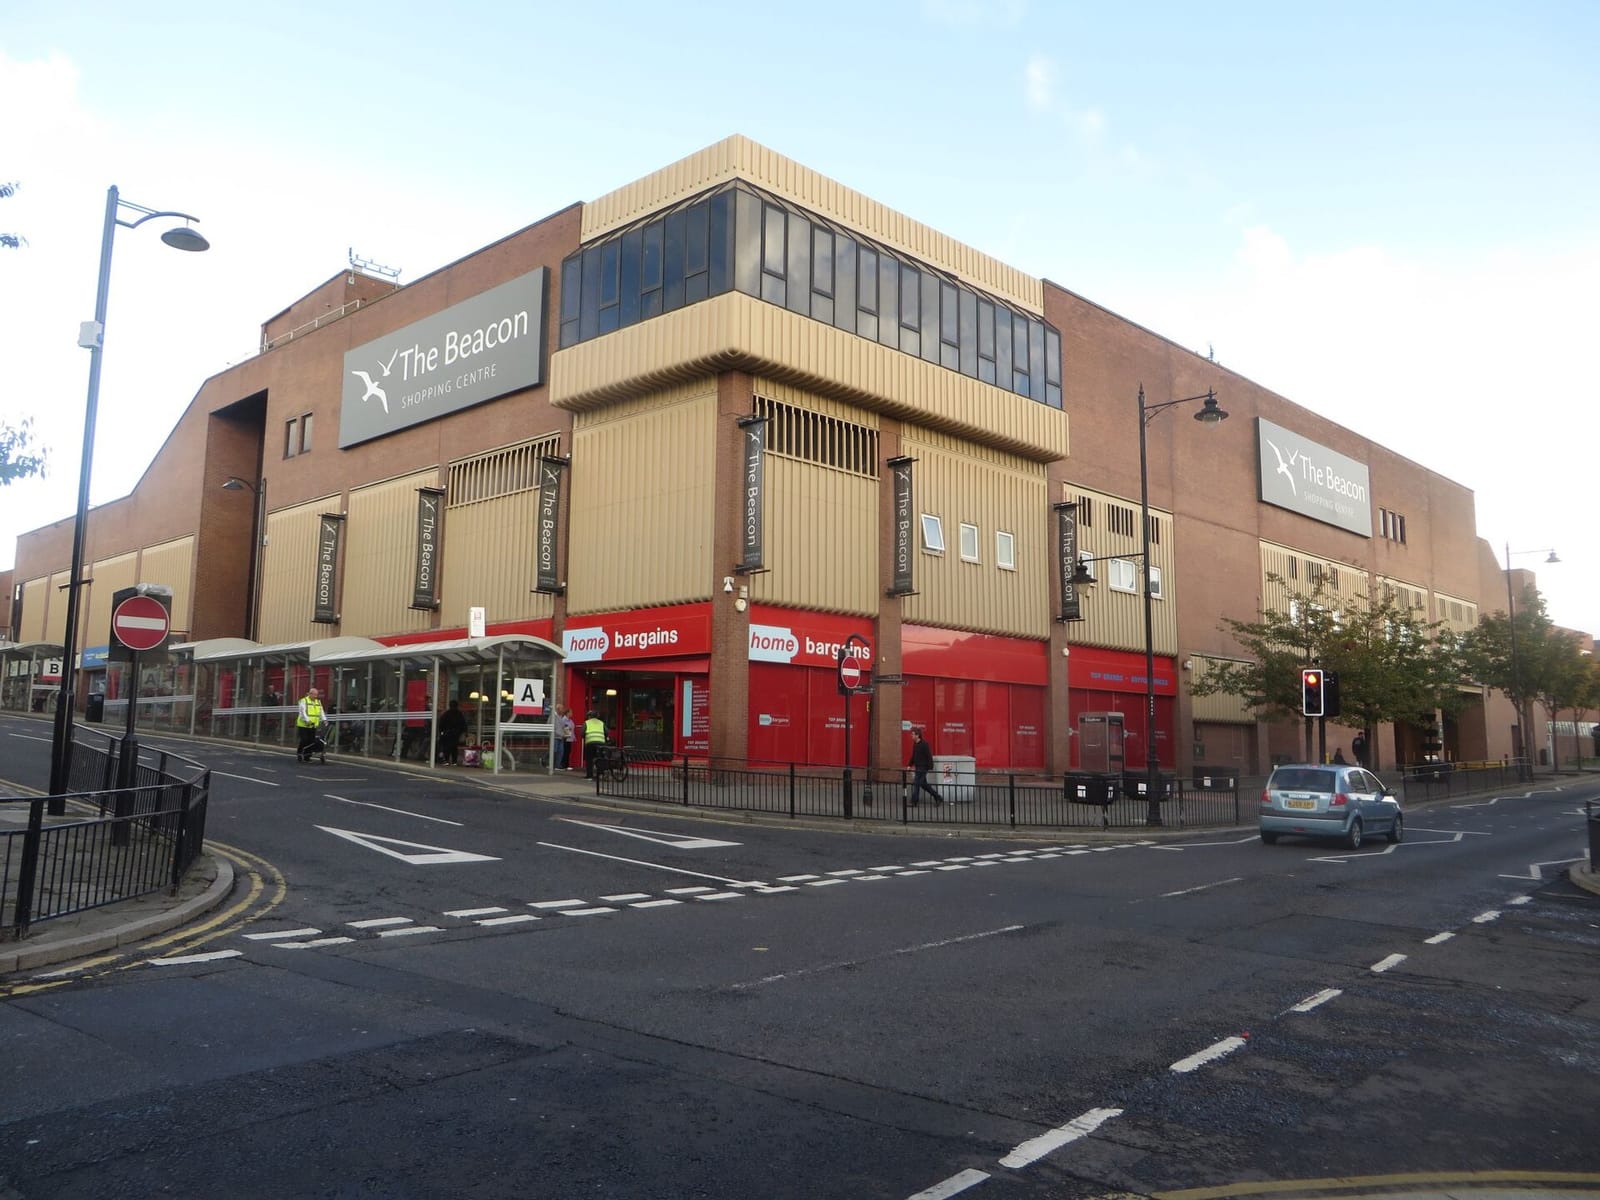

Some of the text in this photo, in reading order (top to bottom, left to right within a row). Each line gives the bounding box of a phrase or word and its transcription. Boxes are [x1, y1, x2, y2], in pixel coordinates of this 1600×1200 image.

[400, 310, 528, 380] The Beacon
[401, 364, 497, 408] SHOPPING CENTRE
[748, 450, 759, 482] The
[1300, 455, 1366, 503] The Beacon
[543, 490, 556, 516] The
[747, 486, 759, 545] Beacon
[898, 488, 910, 516] The
[423, 516, 435, 540] The
[1063, 528, 1073, 553] The
[322, 540, 335, 560] The
[542, 519, 554, 570] Beacon
[898, 520, 910, 572] Beacon
[420, 543, 434, 589] Beacon
[320, 563, 333, 605] Beacon
[570, 627, 678, 651] home bargains
[751, 632, 871, 660] home bargins
[49, 664, 59, 674] B
[521, 683, 535, 702] A
